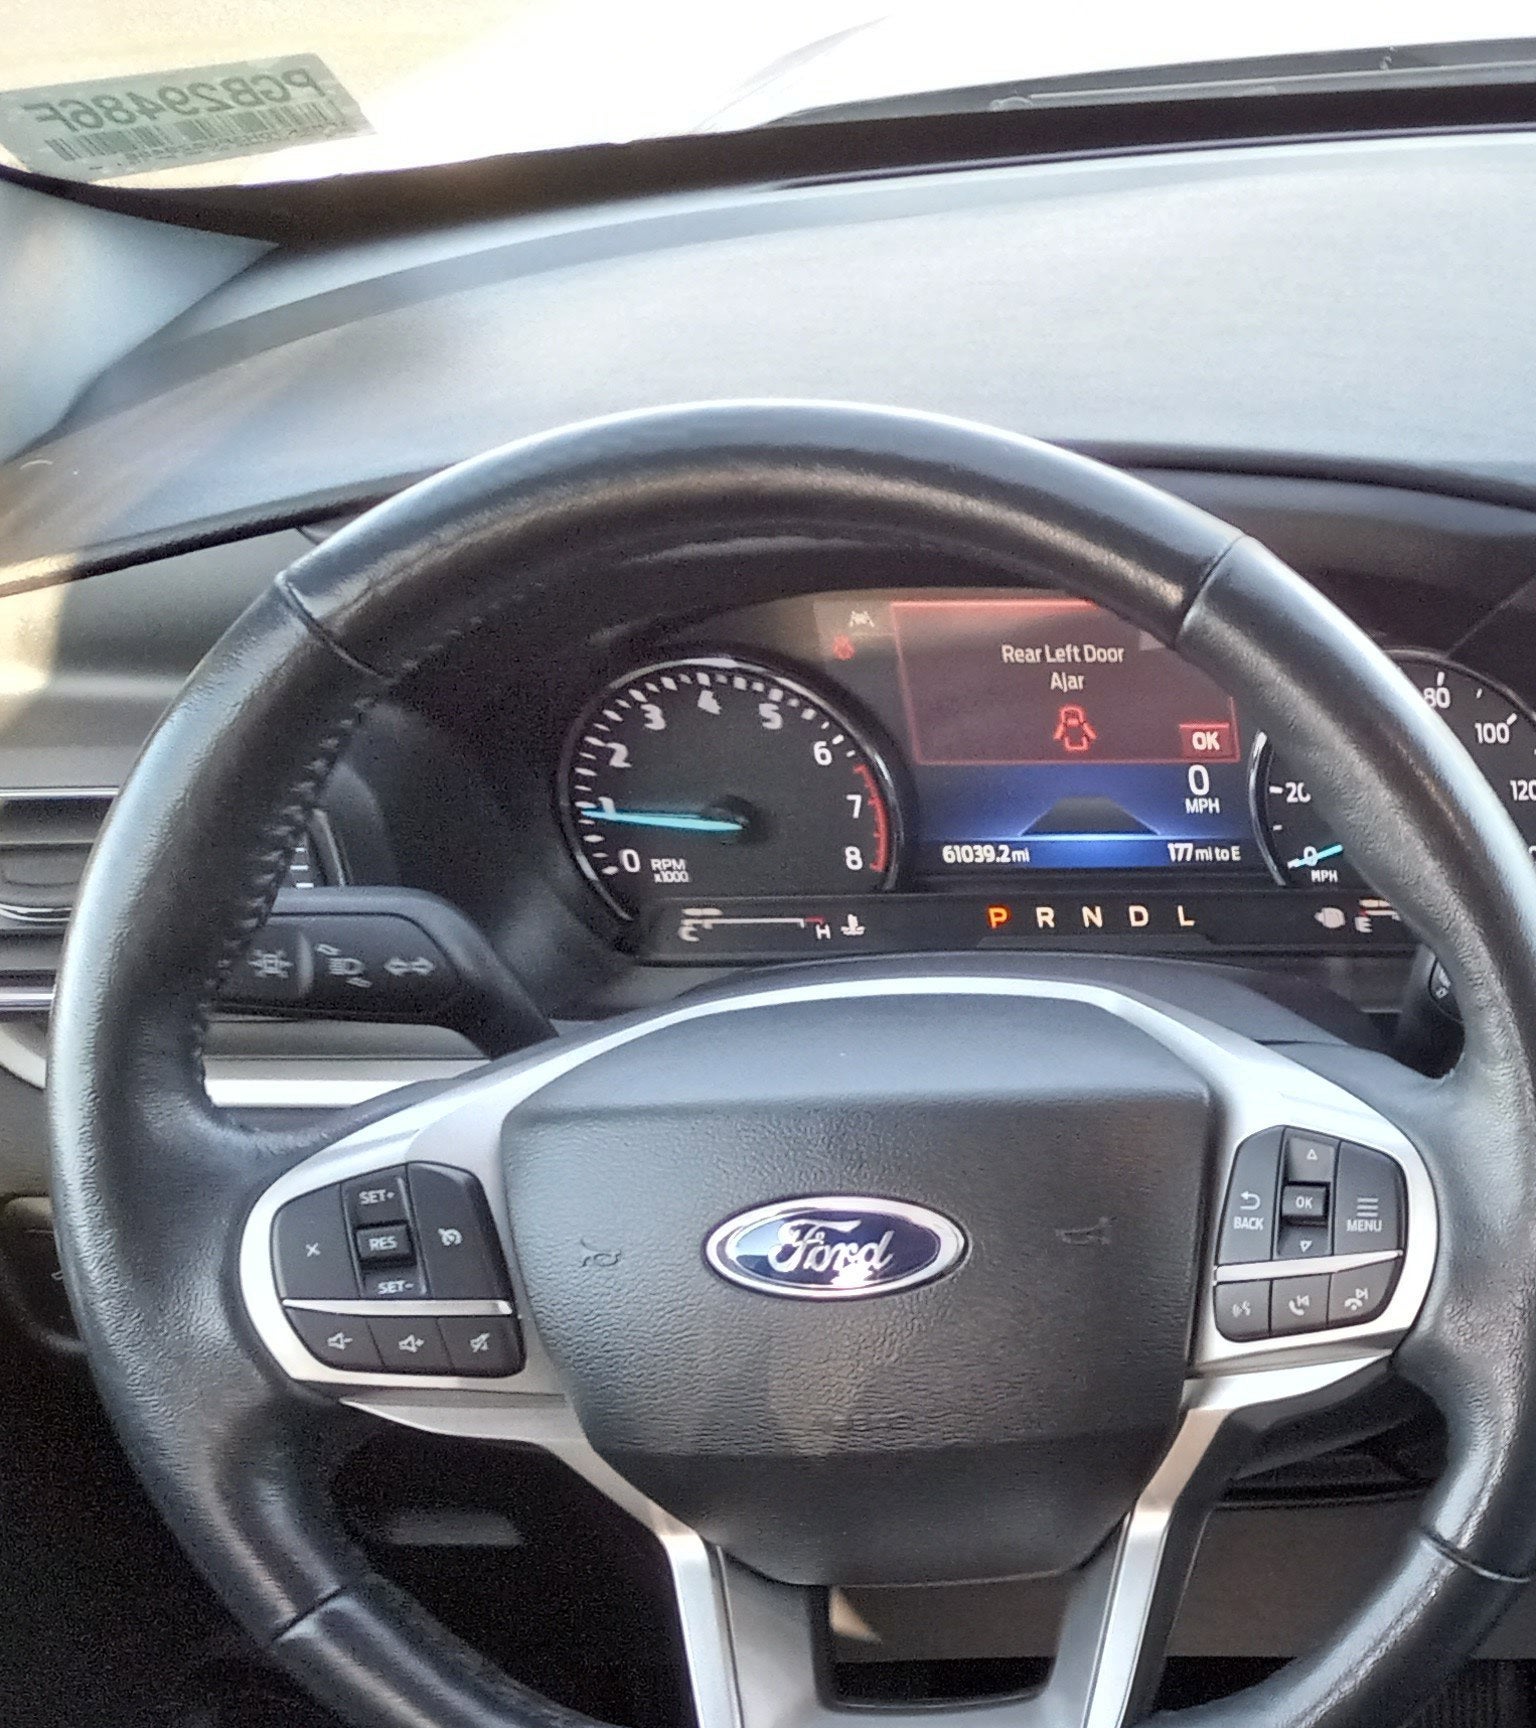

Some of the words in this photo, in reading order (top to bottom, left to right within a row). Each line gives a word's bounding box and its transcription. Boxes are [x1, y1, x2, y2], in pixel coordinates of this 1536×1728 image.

[1001, 643, 1042, 664] Rear
[1044, 643, 1080, 664] Left
[1083, 643, 1124, 664] Door
[640, 703, 666, 730] 3
[758, 703, 784, 729] 5
[1192, 732, 1220, 751] OK
[1475, 722, 1510, 744] 100
[607, 742, 633, 768] 2
[813, 740, 832, 766] 6
[1188, 764, 1210, 796] 0
[846, 794, 862, 818] 7
[1185, 798, 1220, 814] MPH
[618, 849, 641, 873] 0
[651, 859, 685, 871] RPM
[844, 846, 863, 870] 8
[942, 845, 1010, 864] 61039.2
[1311, 870, 1338, 883] MPH
[987, 906, 1009, 929] P
[1035, 906, 1055, 928] R
[1082, 905, 1103, 928] N
[1129, 905, 1149, 927] D
[1177, 905, 1195, 926] L
[1296, 1196, 1313, 1209] OK
[1234, 1217, 1263, 1230] BACK
[1346, 1220, 1382, 1232] MENU
[369, 1236, 397, 1250] RES
[767, 1218, 894, 1274] Ford
